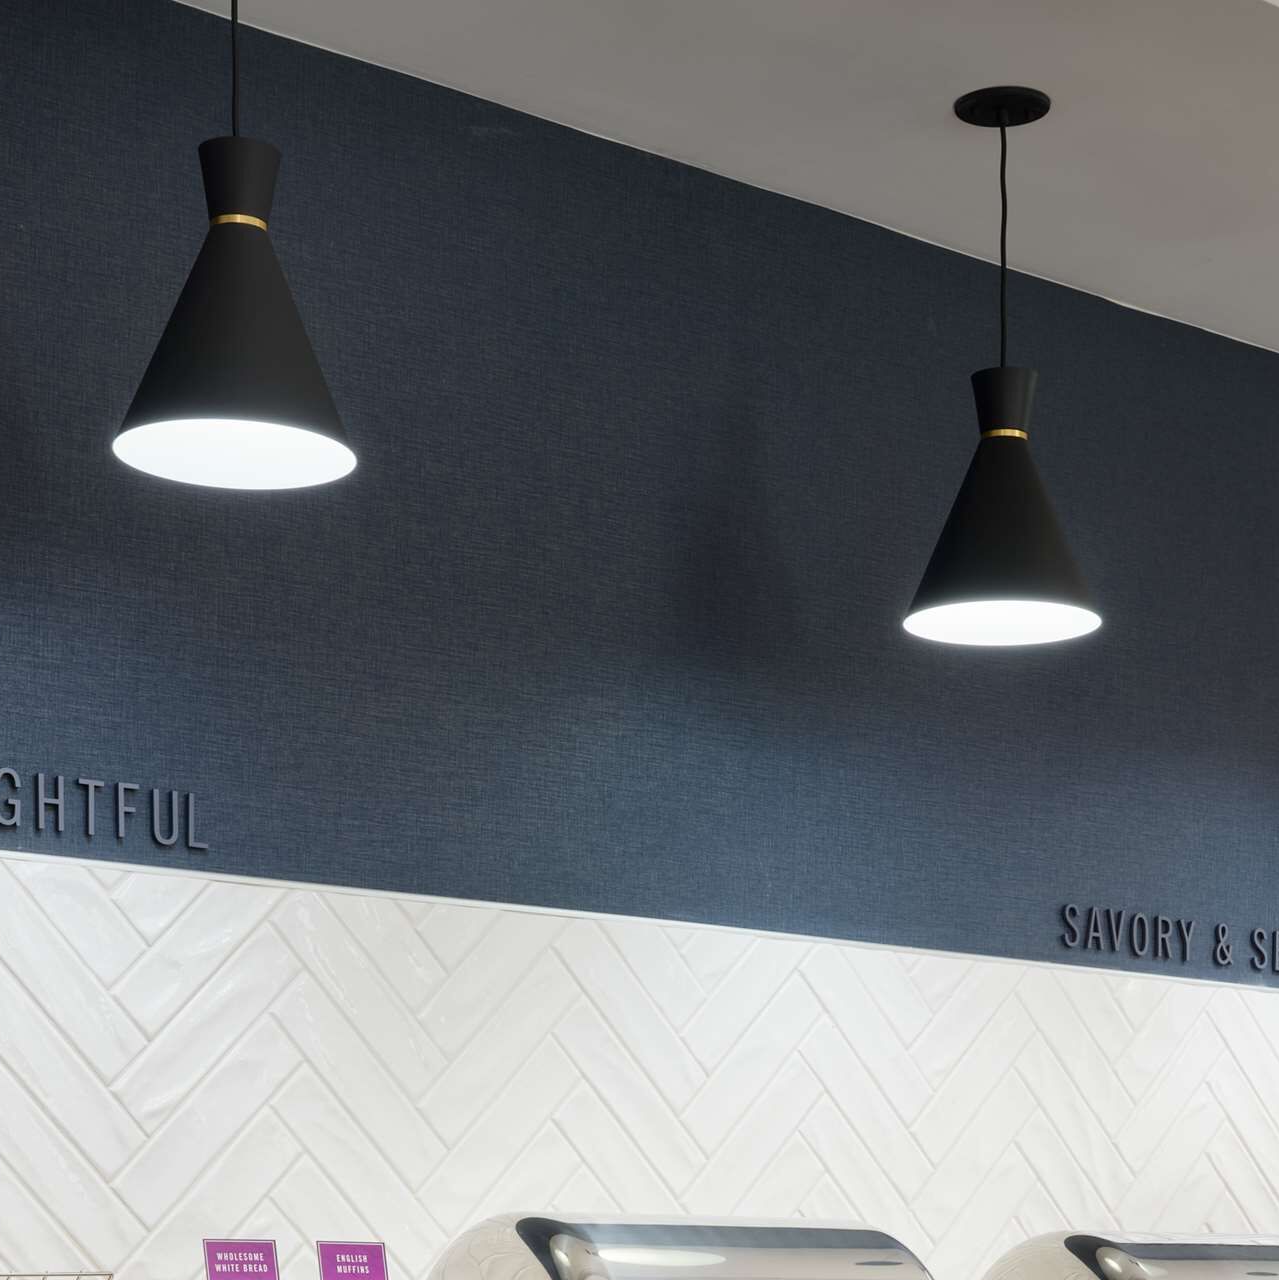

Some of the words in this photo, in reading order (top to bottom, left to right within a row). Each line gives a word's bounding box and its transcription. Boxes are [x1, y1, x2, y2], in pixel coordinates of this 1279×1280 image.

[1061, 903, 1196, 963] SAVORY
[1215, 922, 1234, 966] &
[216, 1252, 265, 1262] WHOLESOME
[336, 1254, 368, 1263] ENGLISH
[214, 1263, 240, 1273] WHITE
[243, 1264, 268, 1273] BREAD
[336, 1265, 370, 1274] MUFFINS
